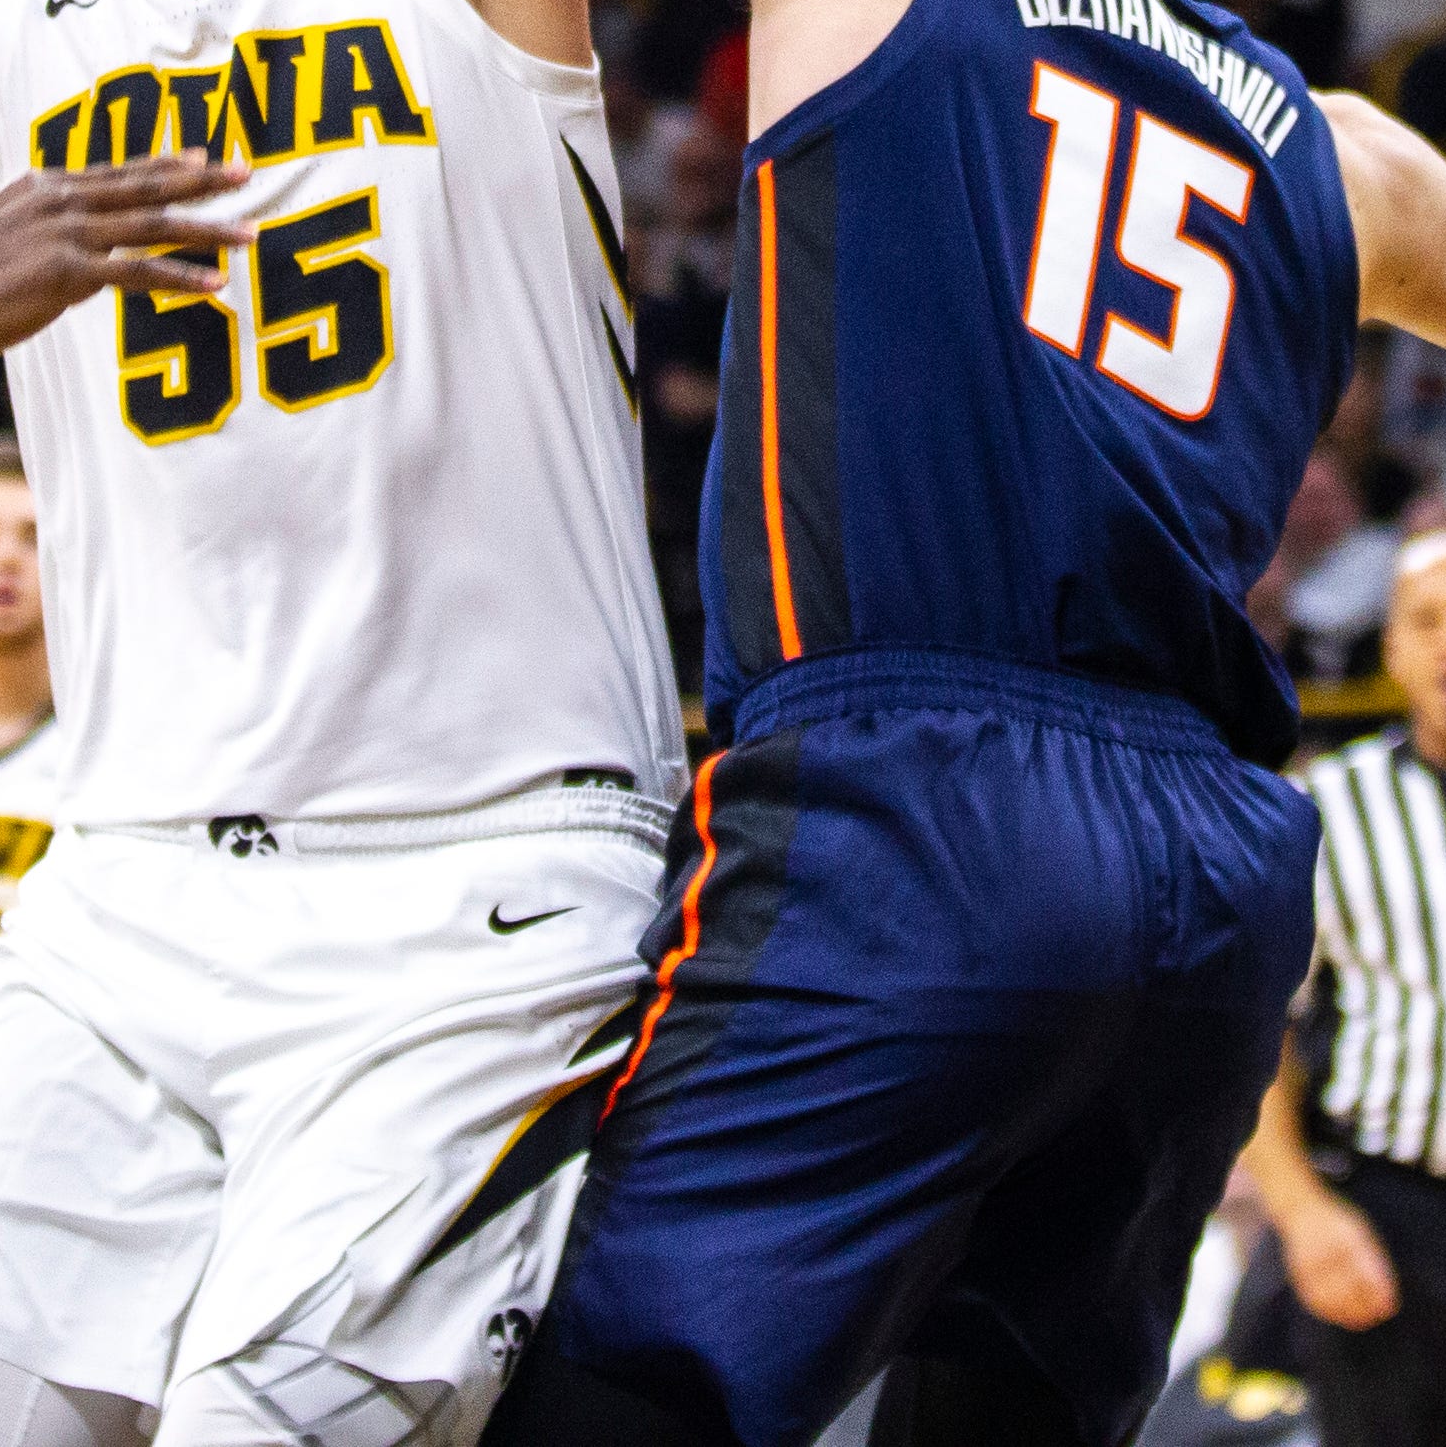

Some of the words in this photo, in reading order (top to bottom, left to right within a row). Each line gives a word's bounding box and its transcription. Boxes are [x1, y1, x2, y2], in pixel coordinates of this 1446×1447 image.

[30, 19, 439, 173] IOWA
[112, 186, 395, 447] 55
[1022, 60, 1256, 422] 15
